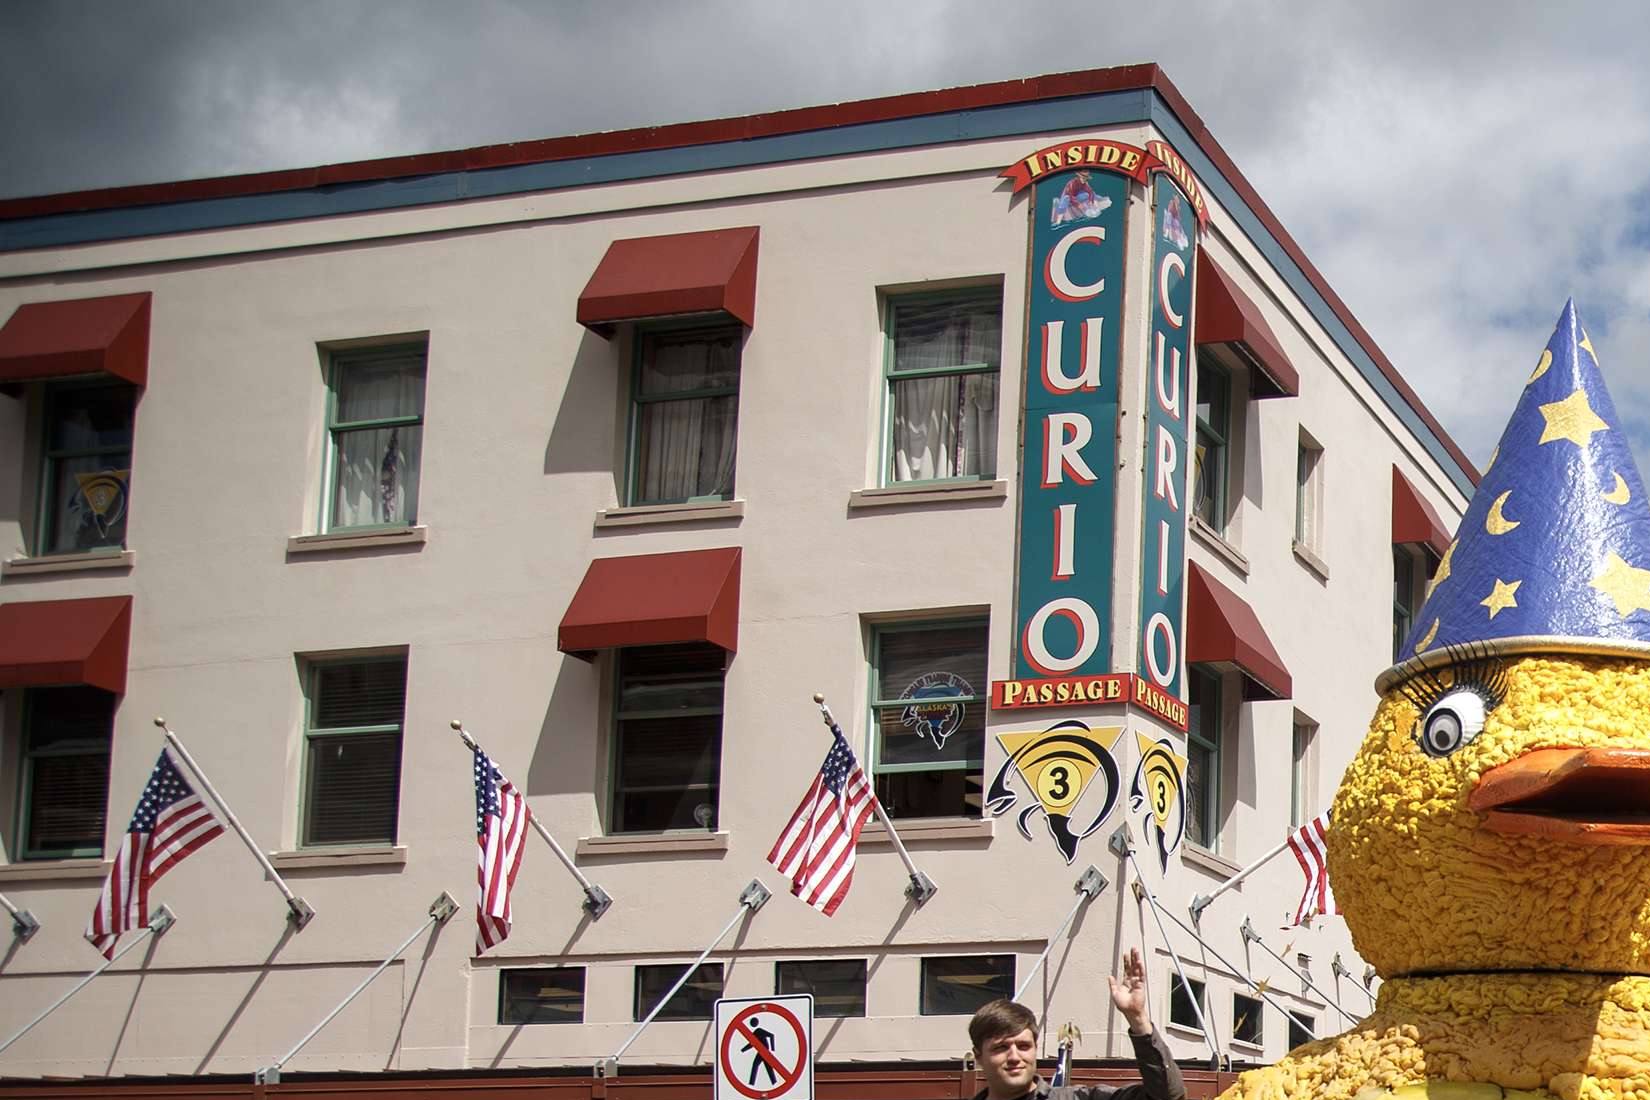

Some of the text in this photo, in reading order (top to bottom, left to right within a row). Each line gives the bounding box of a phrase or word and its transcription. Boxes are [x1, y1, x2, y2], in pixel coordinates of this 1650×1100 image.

[1025, 144, 1141, 178] INSIDE
[1155, 142, 1204, 214] INSIDE
[1023, 226, 1106, 675] CURIO
[1145, 252, 1186, 688] CURIO
[96, 488, 107, 507] 3
[1003, 679, 1122, 704] PASSAGE
[1137, 678, 1186, 726] PASSAGE
[1049, 766, 1070, 800] 3
[1157, 780, 1166, 814] 3
